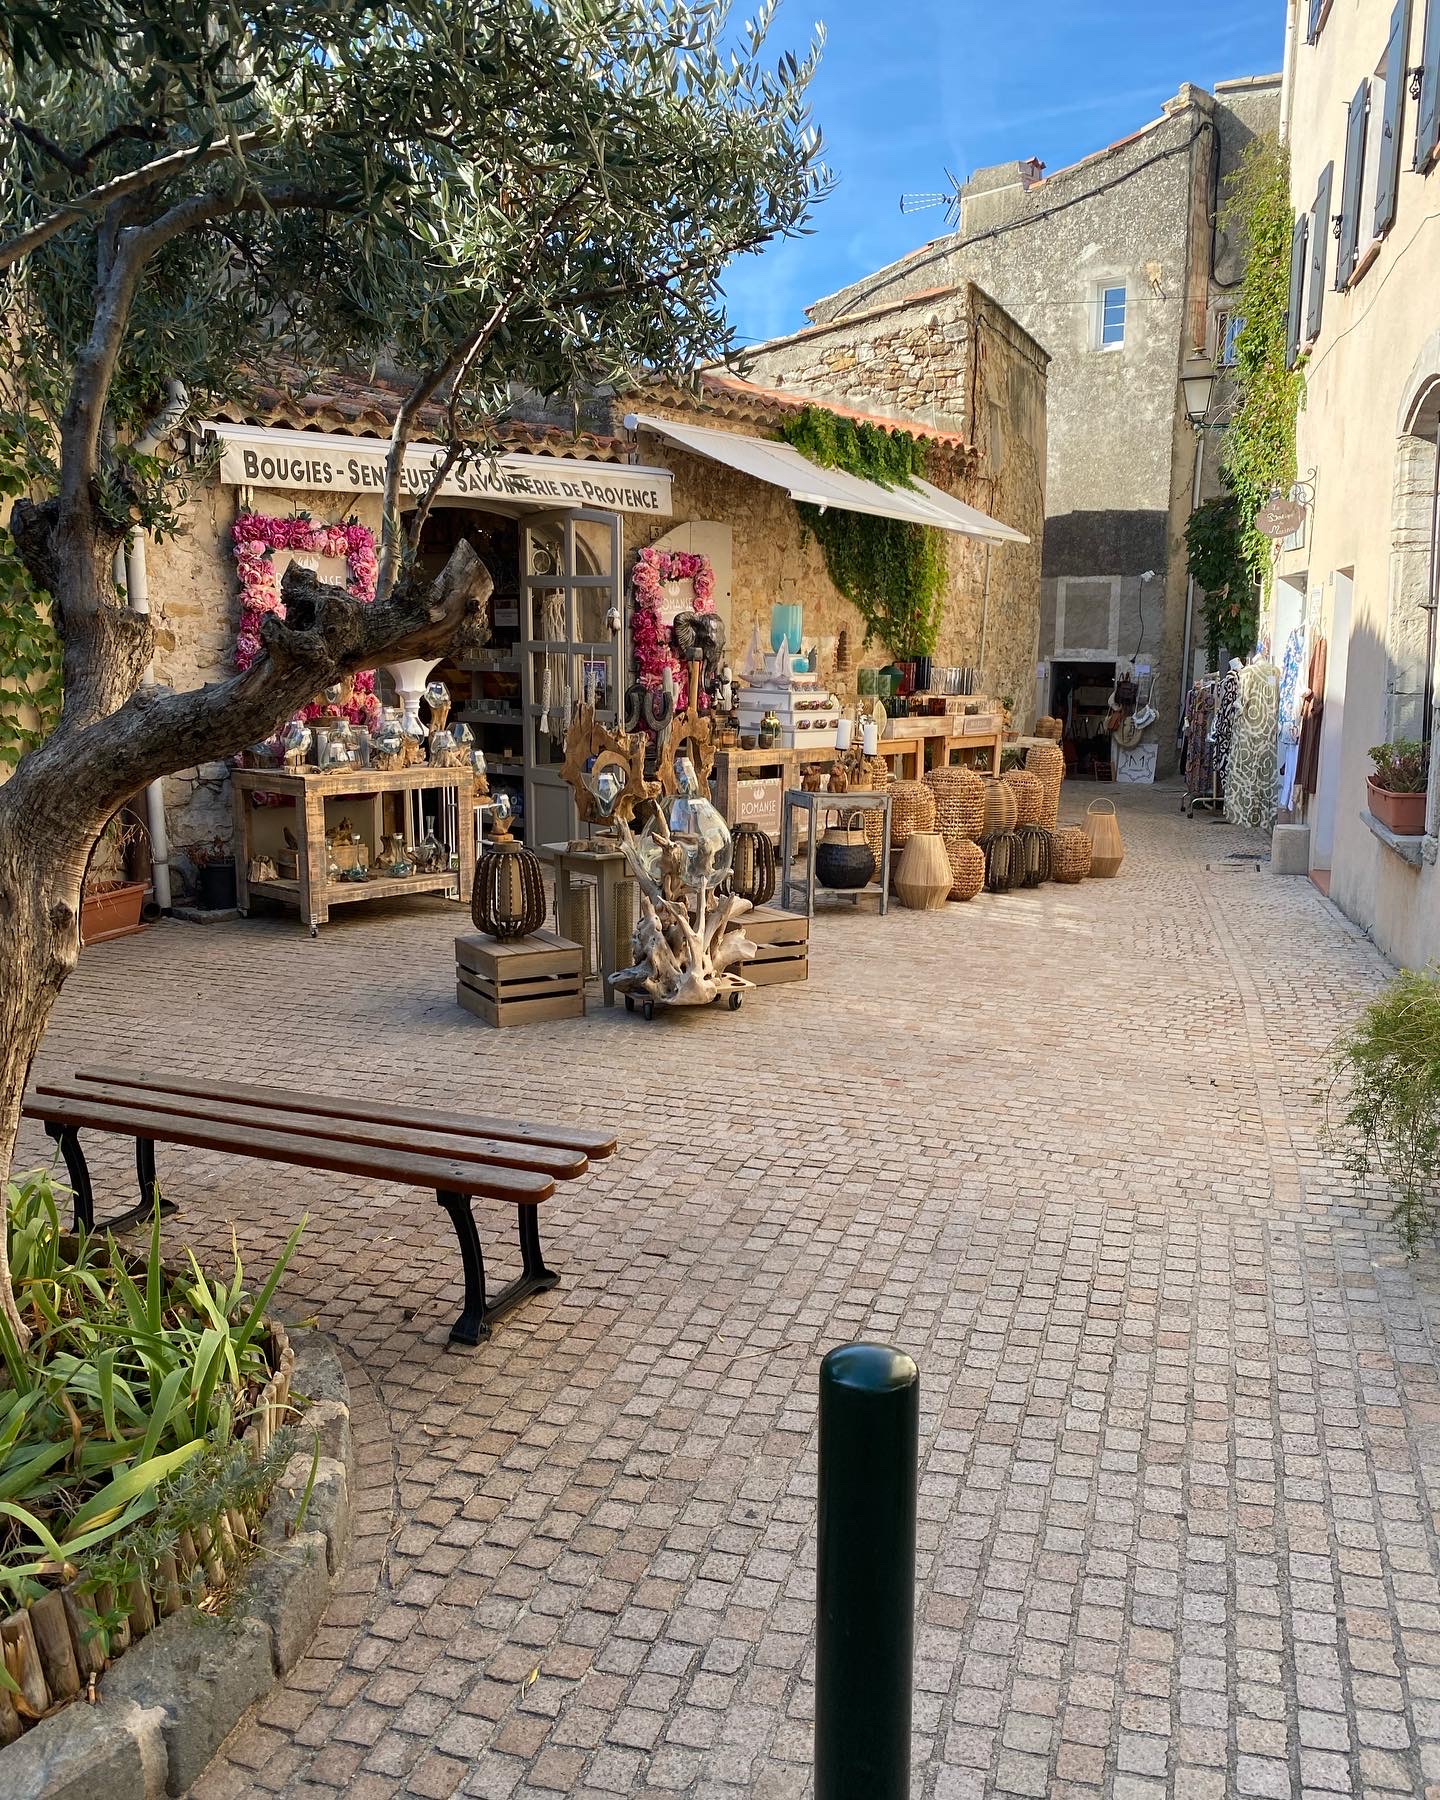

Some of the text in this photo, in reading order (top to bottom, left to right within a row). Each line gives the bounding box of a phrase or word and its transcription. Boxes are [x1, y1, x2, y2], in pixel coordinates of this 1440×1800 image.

[243, 450, 332, 484] BOUGIES
[348, 458, 441, 489] SENEUR
[560, 482, 583, 498] DE
[582, 480, 659, 509] PROVENCE
[654, 527, 660, 538] 3
[662, 598, 693, 611] OMANSE
[741, 800, 776, 815] ROMANSE
